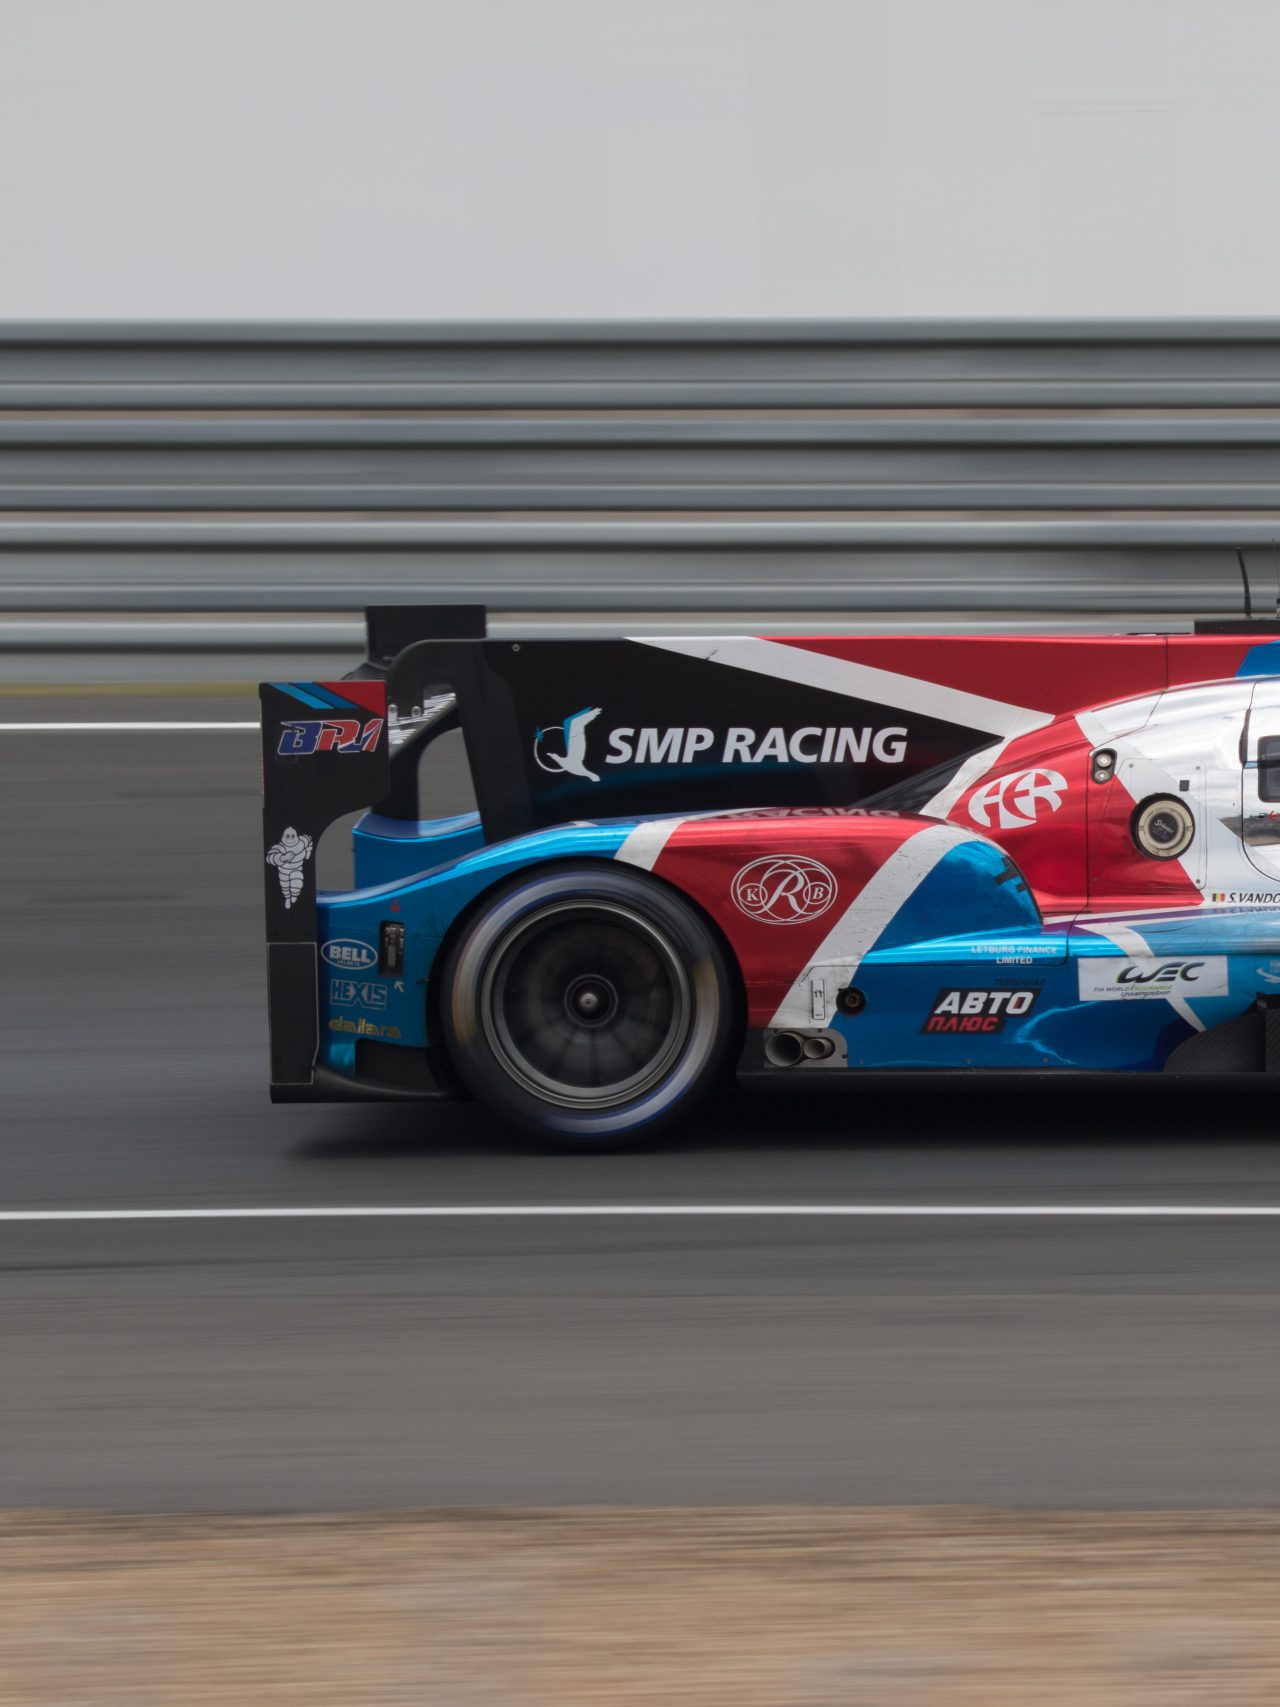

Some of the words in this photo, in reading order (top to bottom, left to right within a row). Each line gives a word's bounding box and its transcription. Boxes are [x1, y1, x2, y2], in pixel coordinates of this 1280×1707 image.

[605, 727, 715, 764] SMP
[722, 726, 909, 764] RACING
[329, 945, 370, 963] BELL
[996, 956, 1033, 964] LIMITED
[1018, 945, 1057, 954] FINANCE
[1116, 961, 1206, 984] WEC
[330, 979, 388, 1008] HEXIS
[934, 991, 1034, 1015] АВТО
